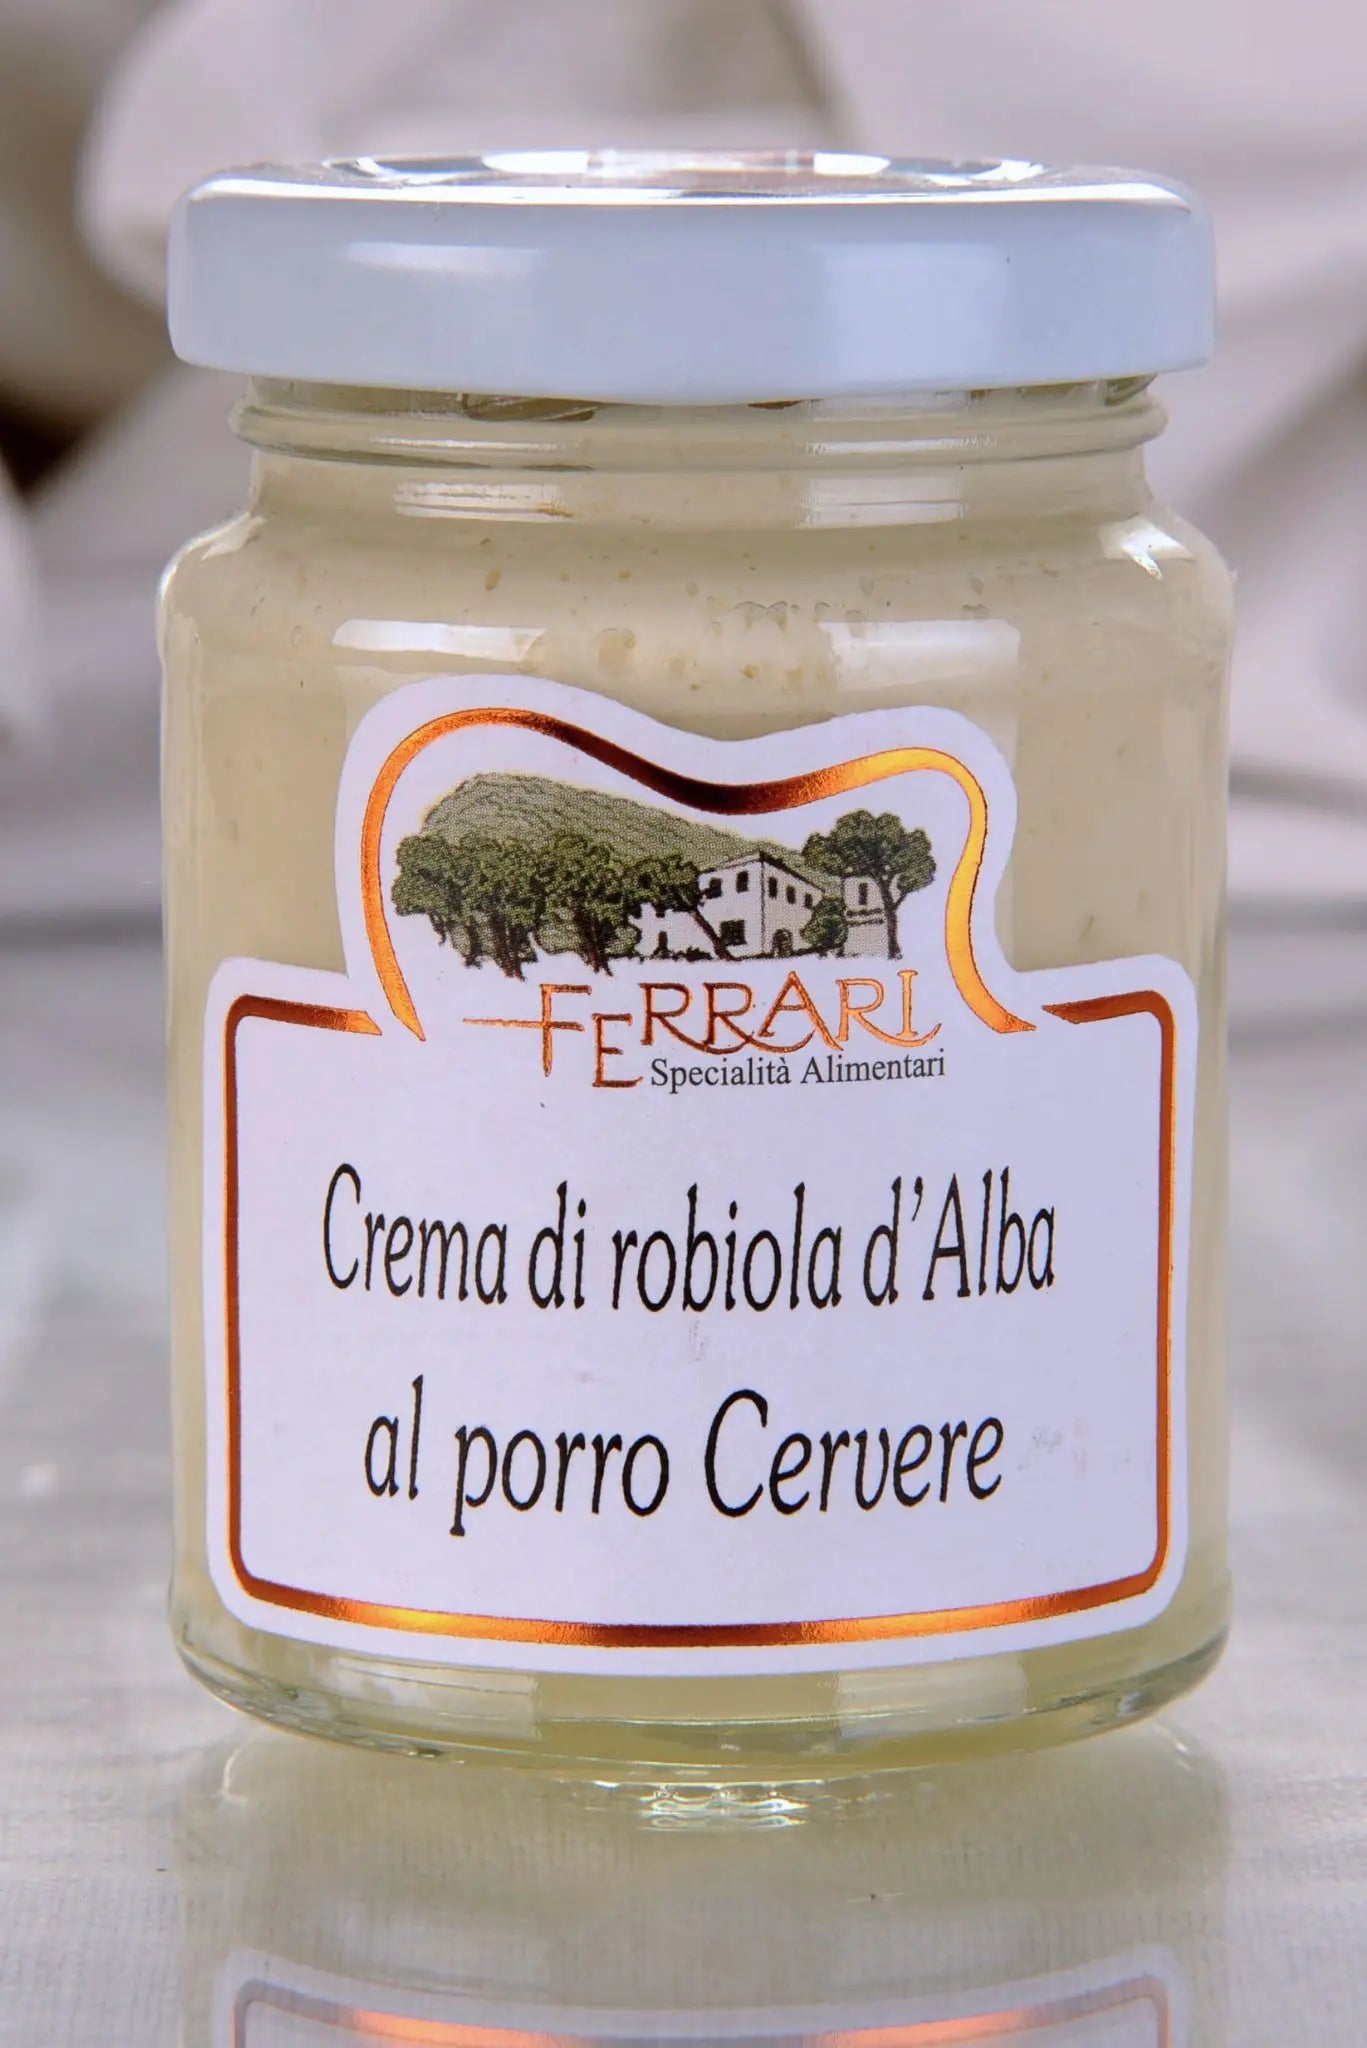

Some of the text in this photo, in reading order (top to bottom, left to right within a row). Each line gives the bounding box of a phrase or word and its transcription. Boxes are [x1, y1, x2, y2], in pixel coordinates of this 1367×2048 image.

[462, 969, 942, 1088] FERRARI
[650, 1047, 946, 1095] Specialità Alimentari
[323, 1163, 508, 1305] Crema
[528, 1180, 587, 1310] di
[611, 1181, 842, 1313] robiola
[364, 1374, 1004, 1537] al porro Cervere
